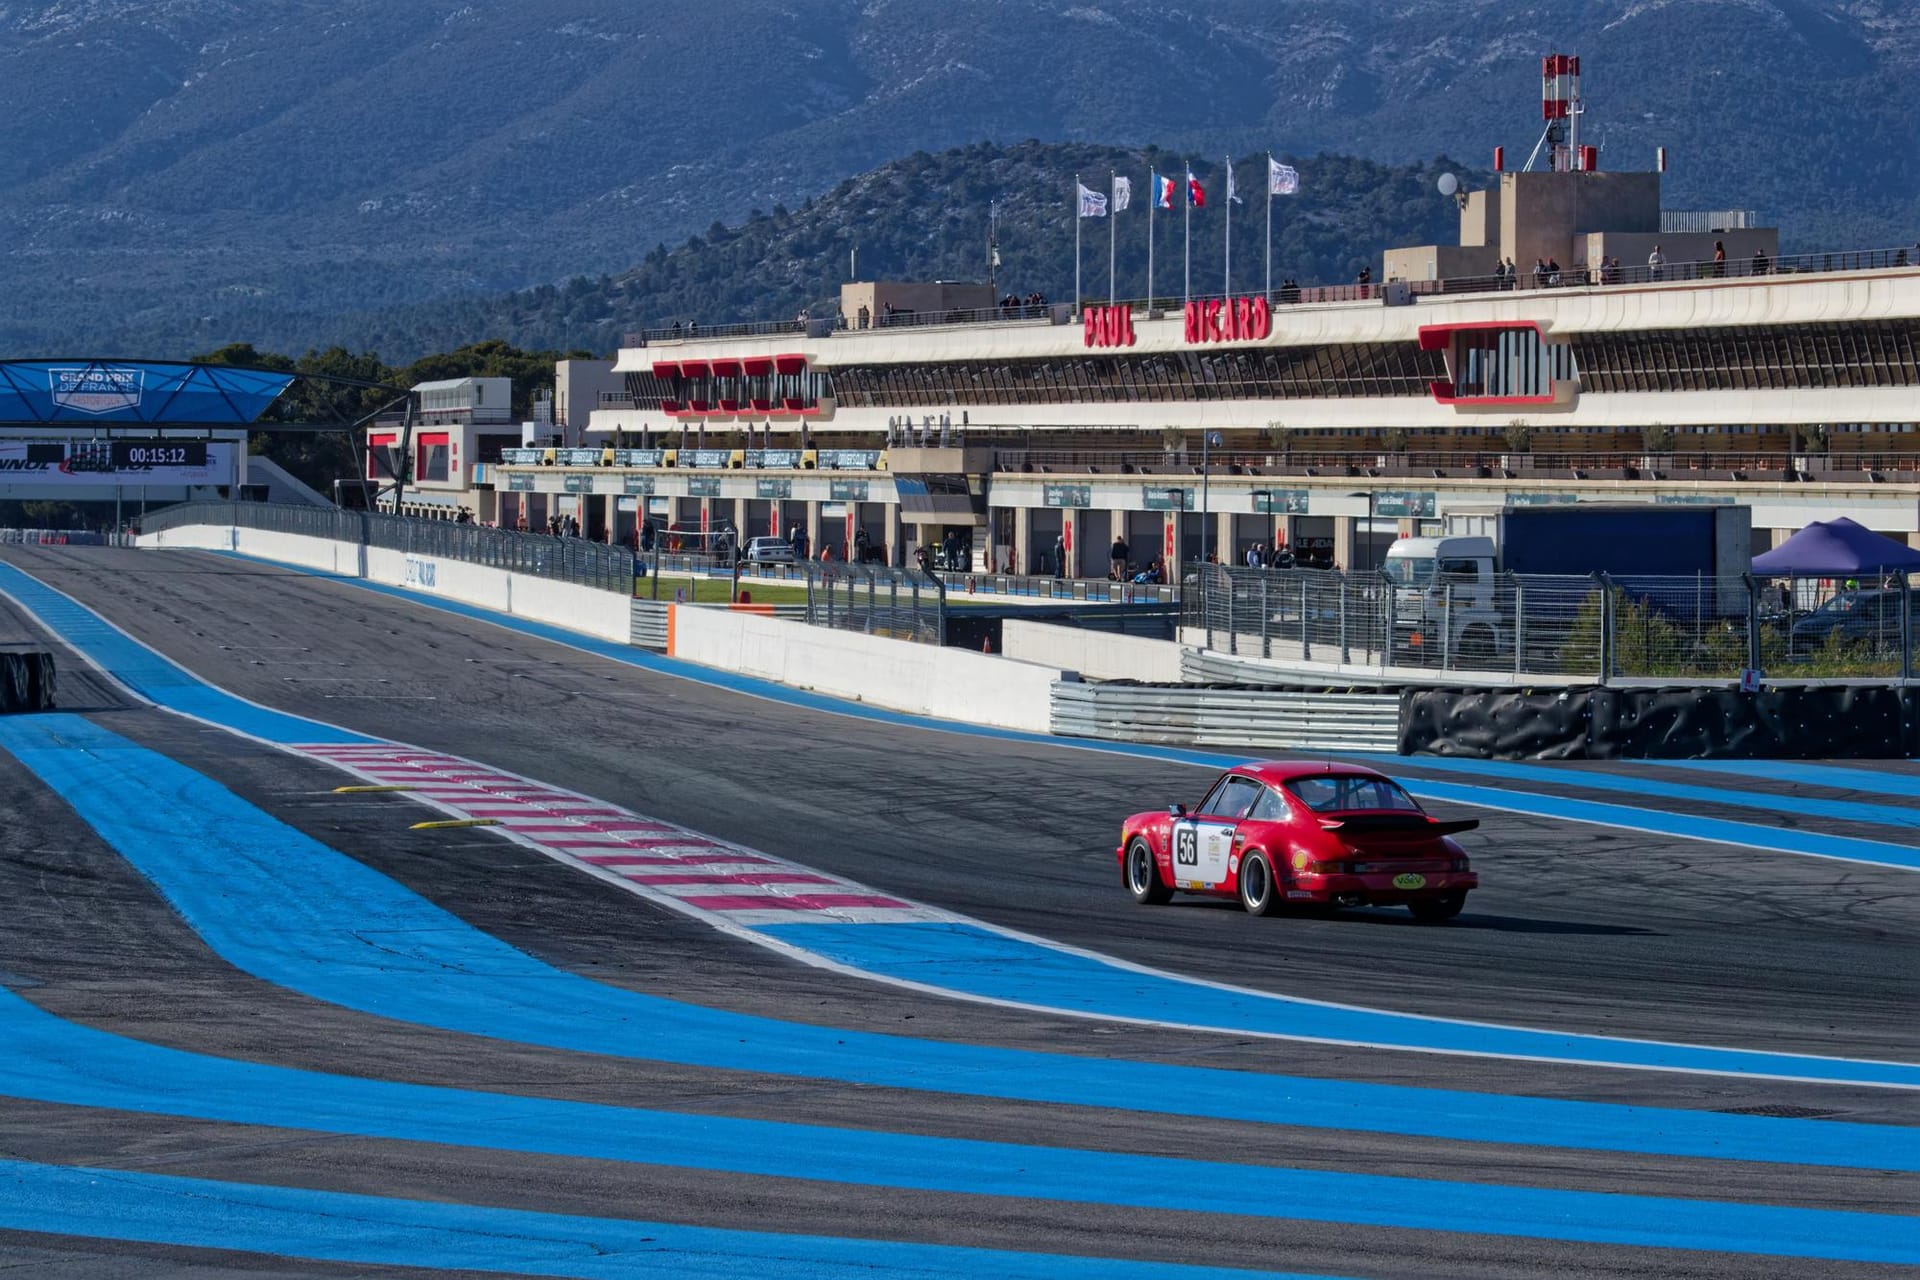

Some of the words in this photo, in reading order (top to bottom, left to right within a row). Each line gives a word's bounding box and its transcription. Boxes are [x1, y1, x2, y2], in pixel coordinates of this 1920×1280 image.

[1084, 305, 1135, 347] PAUL
[1184, 296, 1271, 344] RICARD
[59, 372, 104, 382] GRAND
[105, 373, 134, 383] PRIX
[80, 383, 134, 392] FRANCE
[129, 447, 186, 463] 00:15:12
[1179, 832, 1196, 864] 56
